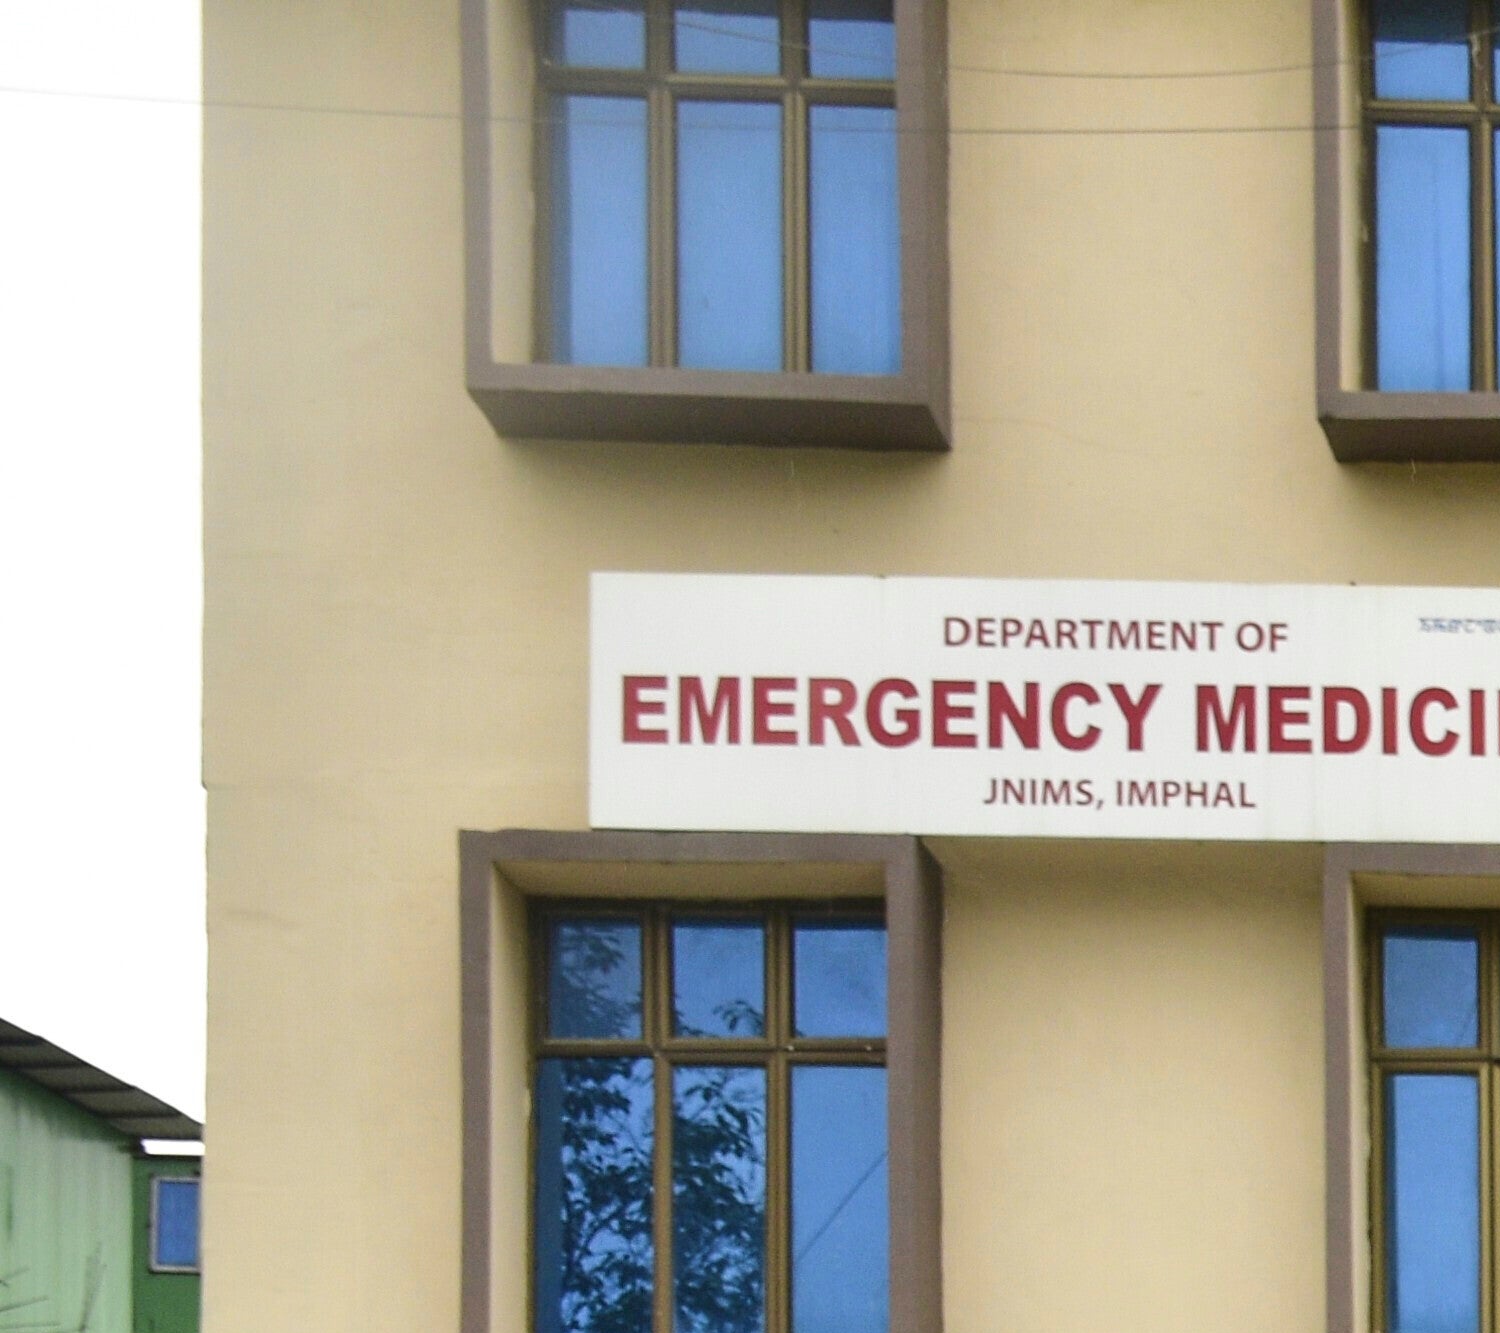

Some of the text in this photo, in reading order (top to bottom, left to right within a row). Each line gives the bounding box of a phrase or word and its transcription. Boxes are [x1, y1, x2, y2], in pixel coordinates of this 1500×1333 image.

[943, 616, 1289, 653] DEPARTMENT OF
[621, 675, 1163, 752] EMERGENCY
[983, 777, 1257, 810] JNIMS, IMPHAL
